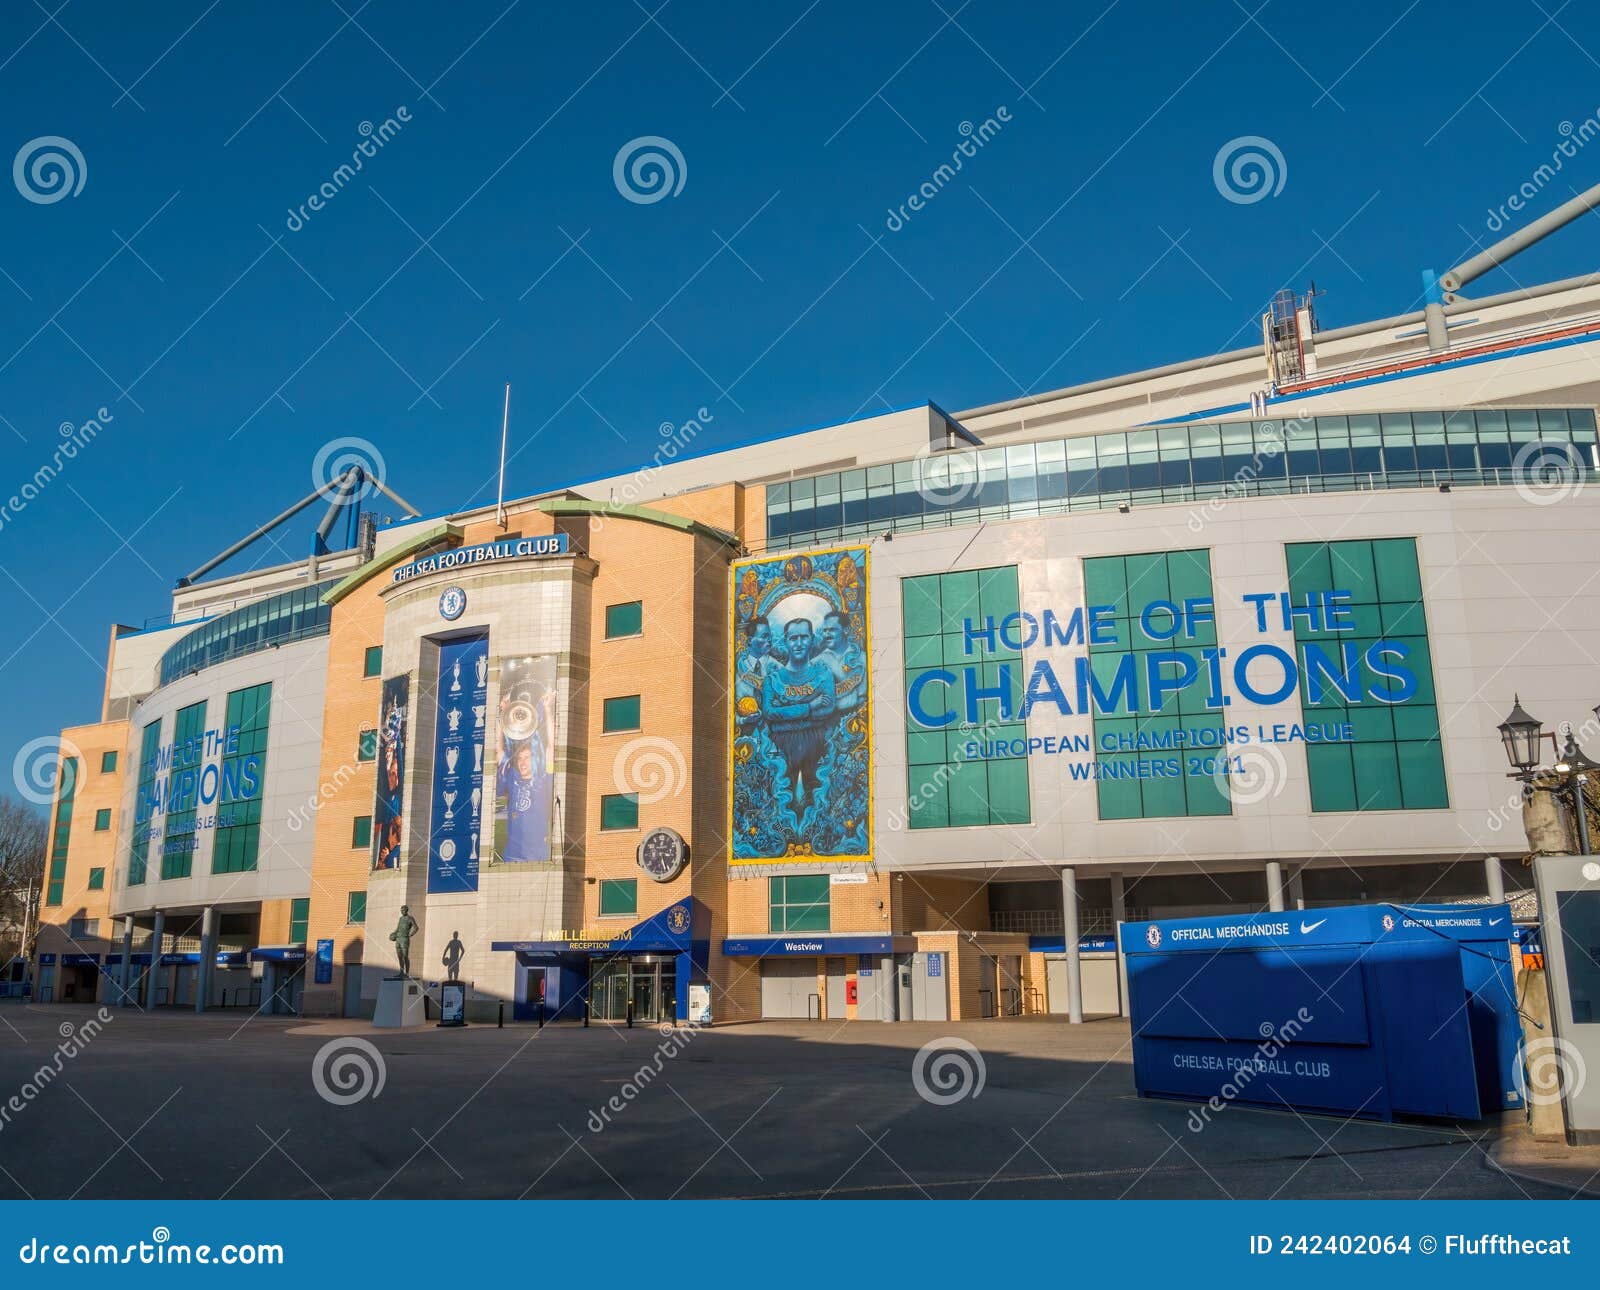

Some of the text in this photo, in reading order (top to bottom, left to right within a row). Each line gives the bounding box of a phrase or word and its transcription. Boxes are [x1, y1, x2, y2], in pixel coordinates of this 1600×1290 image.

[393, 538, 560, 584] CHELSEA FOOTBALL CLUB
[963, 589, 1356, 656] HOME OF THE
[907, 640, 1418, 728] CHAMPIONS
[182, 735, 203, 765] OF
[205, 725, 240, 757] THE
[965, 721, 1356, 760] EUROPEAN CHAMPIONS LEAGUE
[1068, 755, 1247, 781] WINNERS 2021
[135, 755, 260, 824] CHAMPIONS
[1171, 922, 1290, 941] OFFICIAL MERCHANDISE
[1436, 918, 1482, 927] MERCHANDISE
[569, 942, 609, 950] RECEPTION
[784, 942, 822, 952] Westview
[1173, 1054, 1331, 1078] CHELSEA FOOTBALL CLUB
